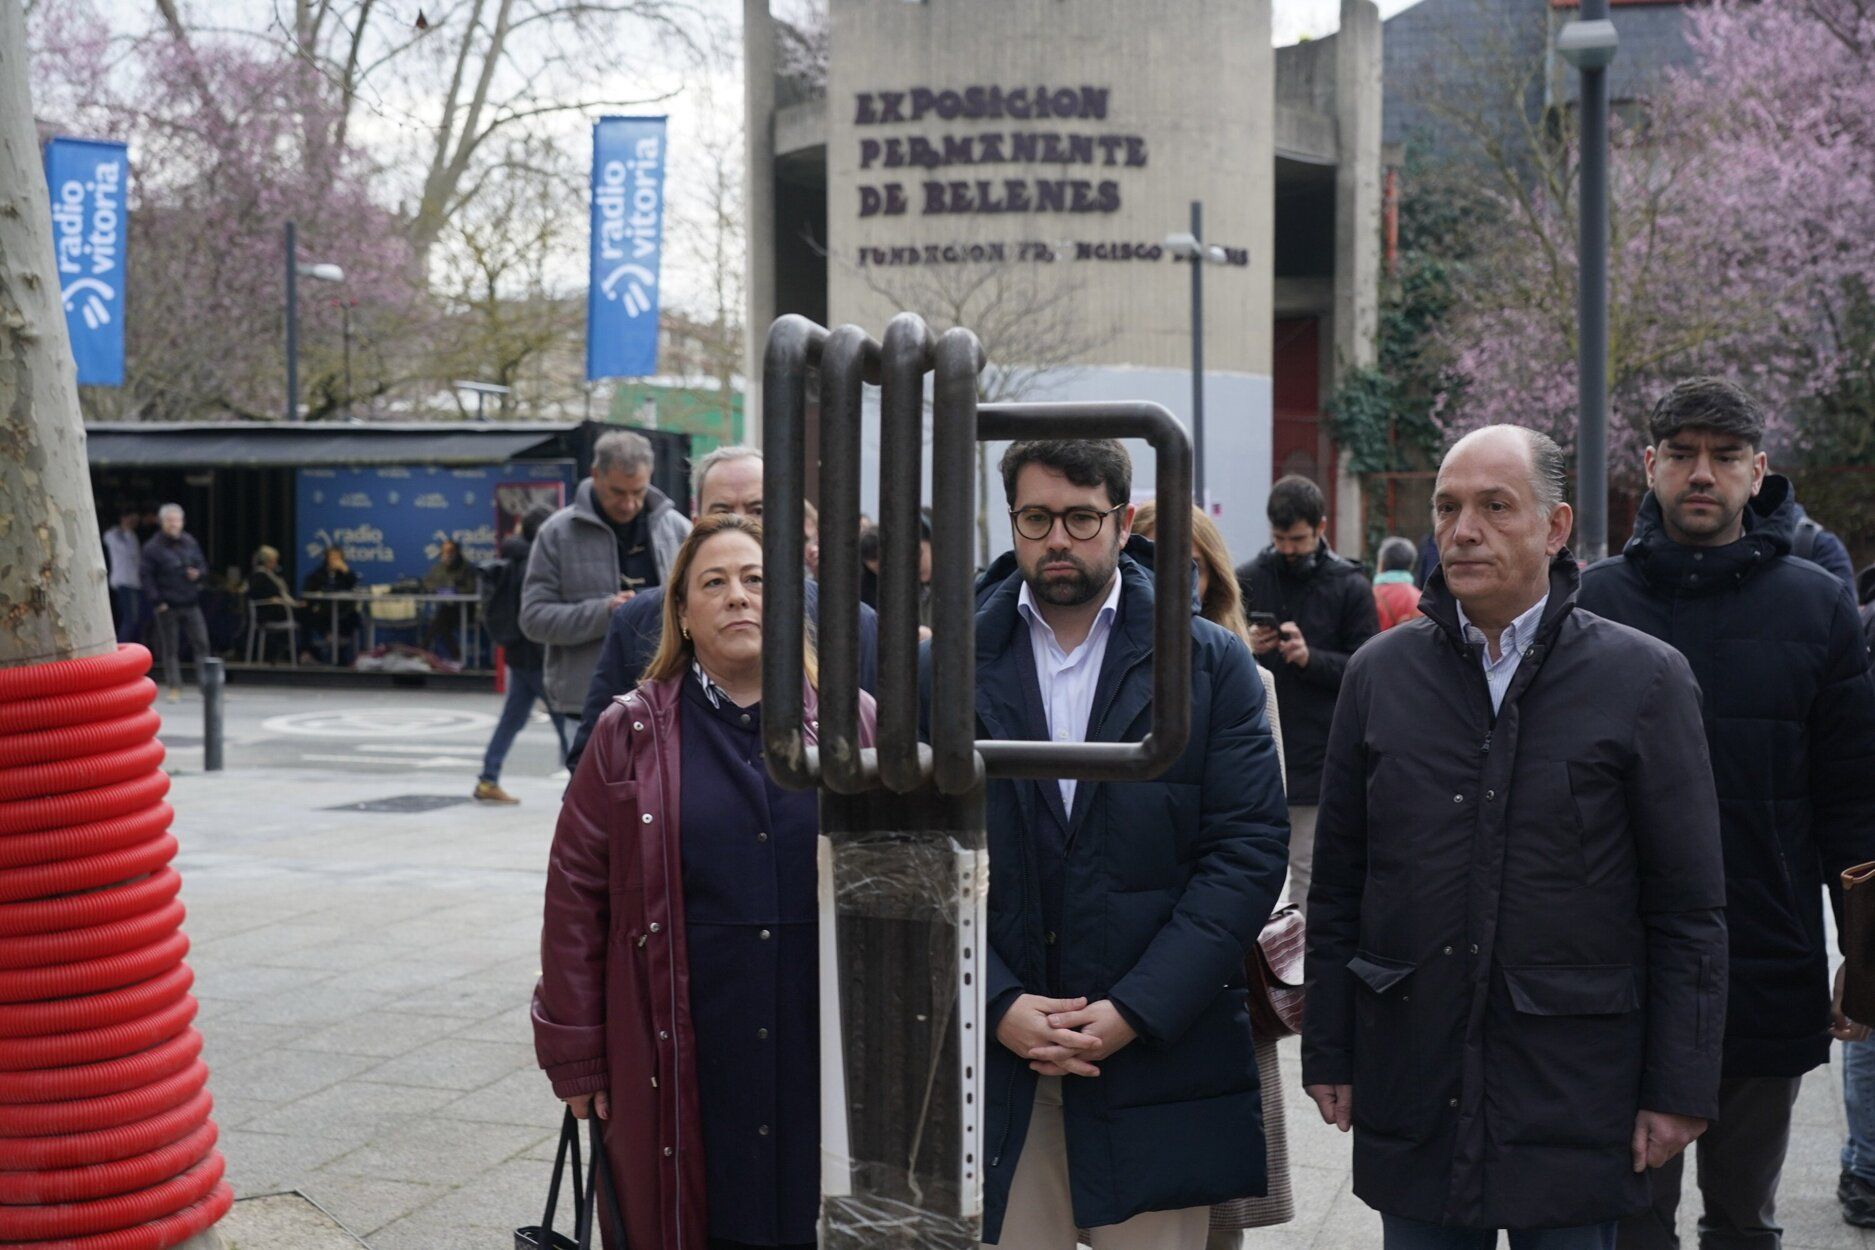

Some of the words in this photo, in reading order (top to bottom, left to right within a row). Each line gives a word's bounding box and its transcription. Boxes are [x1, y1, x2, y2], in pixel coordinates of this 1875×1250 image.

[854, 84, 1110, 125] EXPOSICION
[859, 132, 1148, 169] PERMANENTE
[83, 161, 120, 275] vitoria
[596, 160, 626, 260] radio
[625, 137, 659, 259] vitoria
[858, 183, 907, 217] DE
[922, 179, 1121, 215] BELENES
[53, 180, 84, 274] radio
[1016, 239, 1163, 263] FRNCISCO
[333, 523, 384, 544] radio
